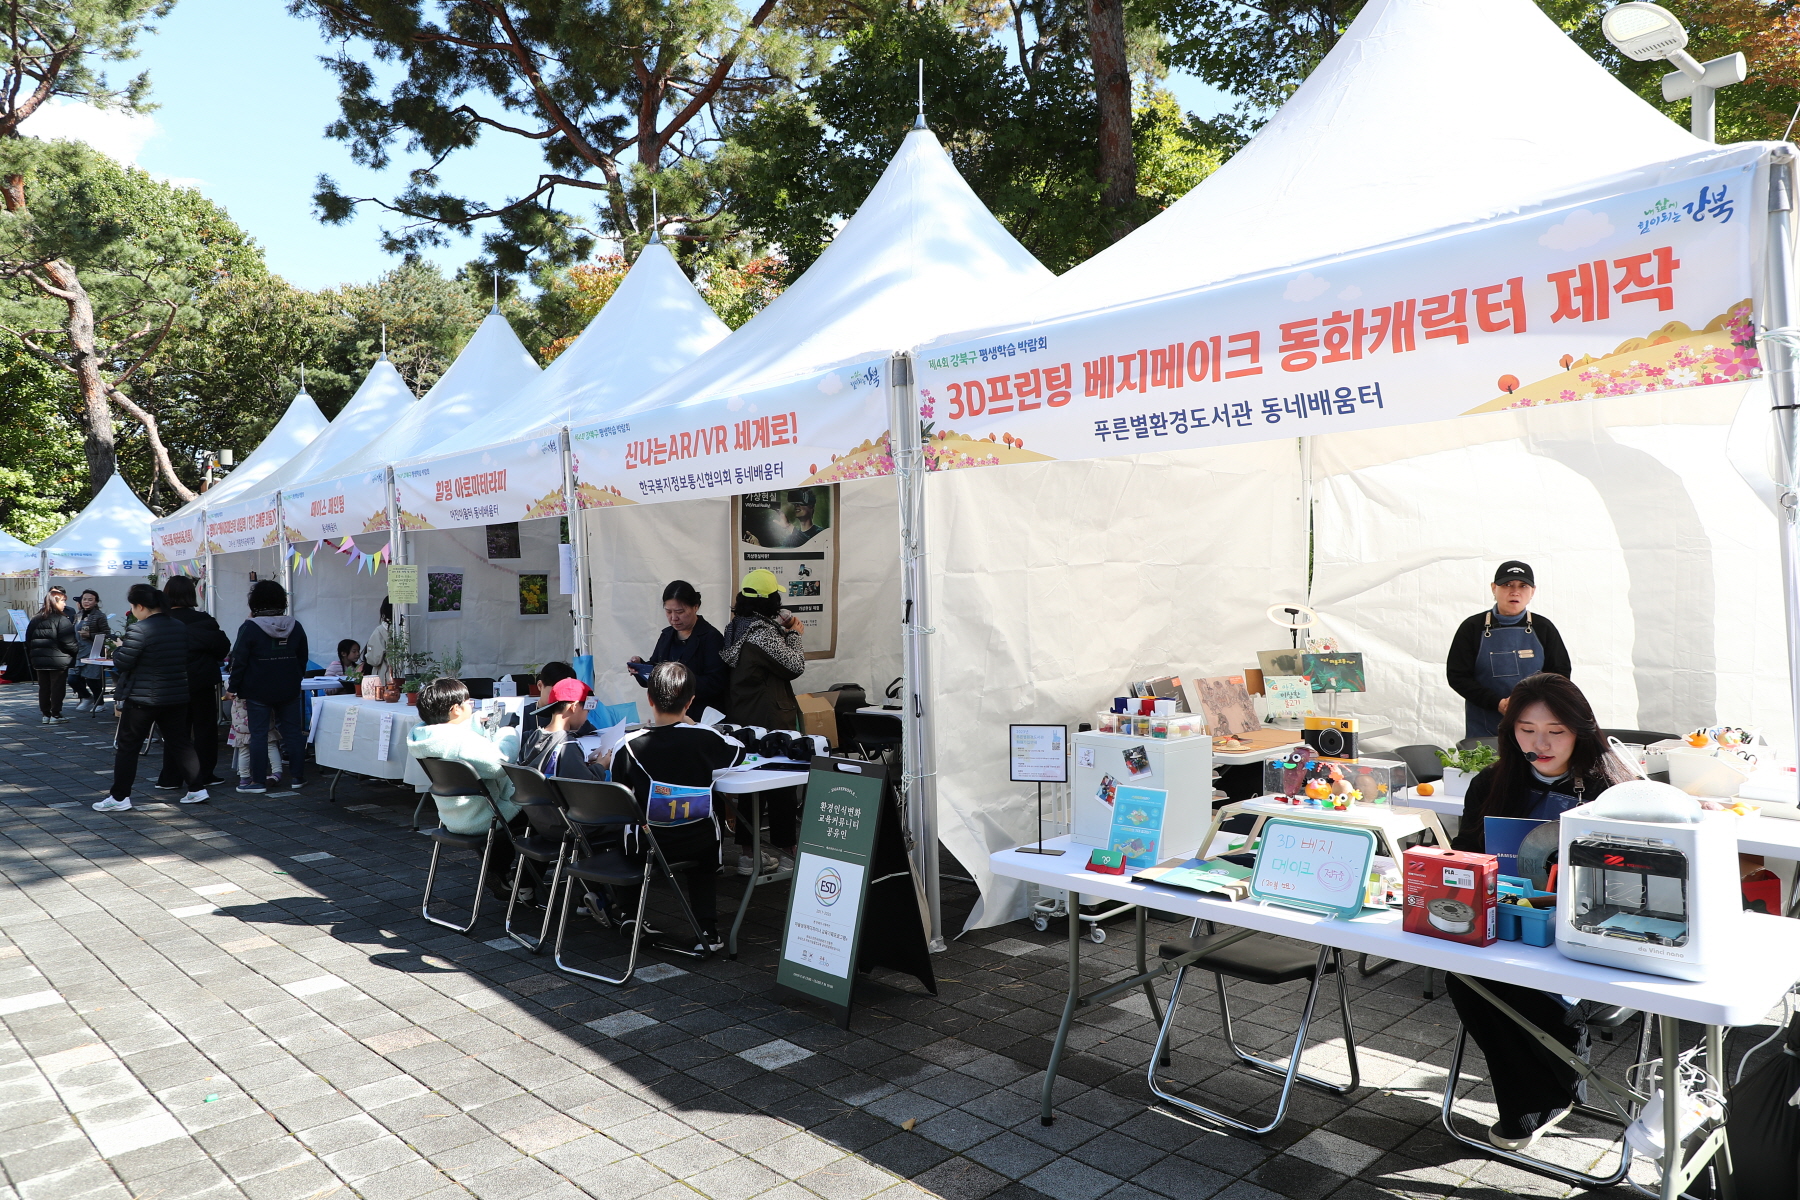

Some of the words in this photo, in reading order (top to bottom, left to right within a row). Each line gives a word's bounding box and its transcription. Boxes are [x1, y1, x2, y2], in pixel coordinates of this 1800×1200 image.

[1682, 184, 1734, 224] 강북
[946, 362, 1073, 420] 3D프린팅
[1082, 330, 1263, 400] 베지메이크
[1278, 276, 1527, 373] 동화캐릭터
[1547, 246, 1681, 324] 제작
[928, 356, 950, 370] 제4회
[950, 350, 978, 368] 강북구
[978, 342, 1016, 362] 평생학습
[1017, 335, 1048, 354] 박람회
[1094, 400, 1253, 442] 푸른별환경도서관
[1260, 381, 1384, 424] 동네배움터
[624, 424, 729, 470] 신나는AR/VR
[733, 411, 798, 452] 세계로!
[435, 478, 453, 502] 힐링
[454, 468, 507, 499] 아로마테라피
[638, 469, 732, 496] 한국복지정보통신협의회
[734, 461, 784, 486] 동네배움터
[310, 499, 327, 518] 페이스
[1280, 690, 1301, 699] 이상한
[668, 799, 690, 820] 11
[819, 801, 861, 818] 환경인식변화
[817, 814, 860, 831] 교육커뮤니티
[826, 826, 847, 840] 공유인
[1277, 834, 1296, 849] 3D
[1300, 837, 1334, 855] 베지
[1271, 858, 1315, 877] 메이크
[1324, 868, 1345, 882] 접수중
[820, 880, 837, 894] ESD
[1648, 946, 1665, 956] Vinci
[1666, 951, 1685, 959] nano
